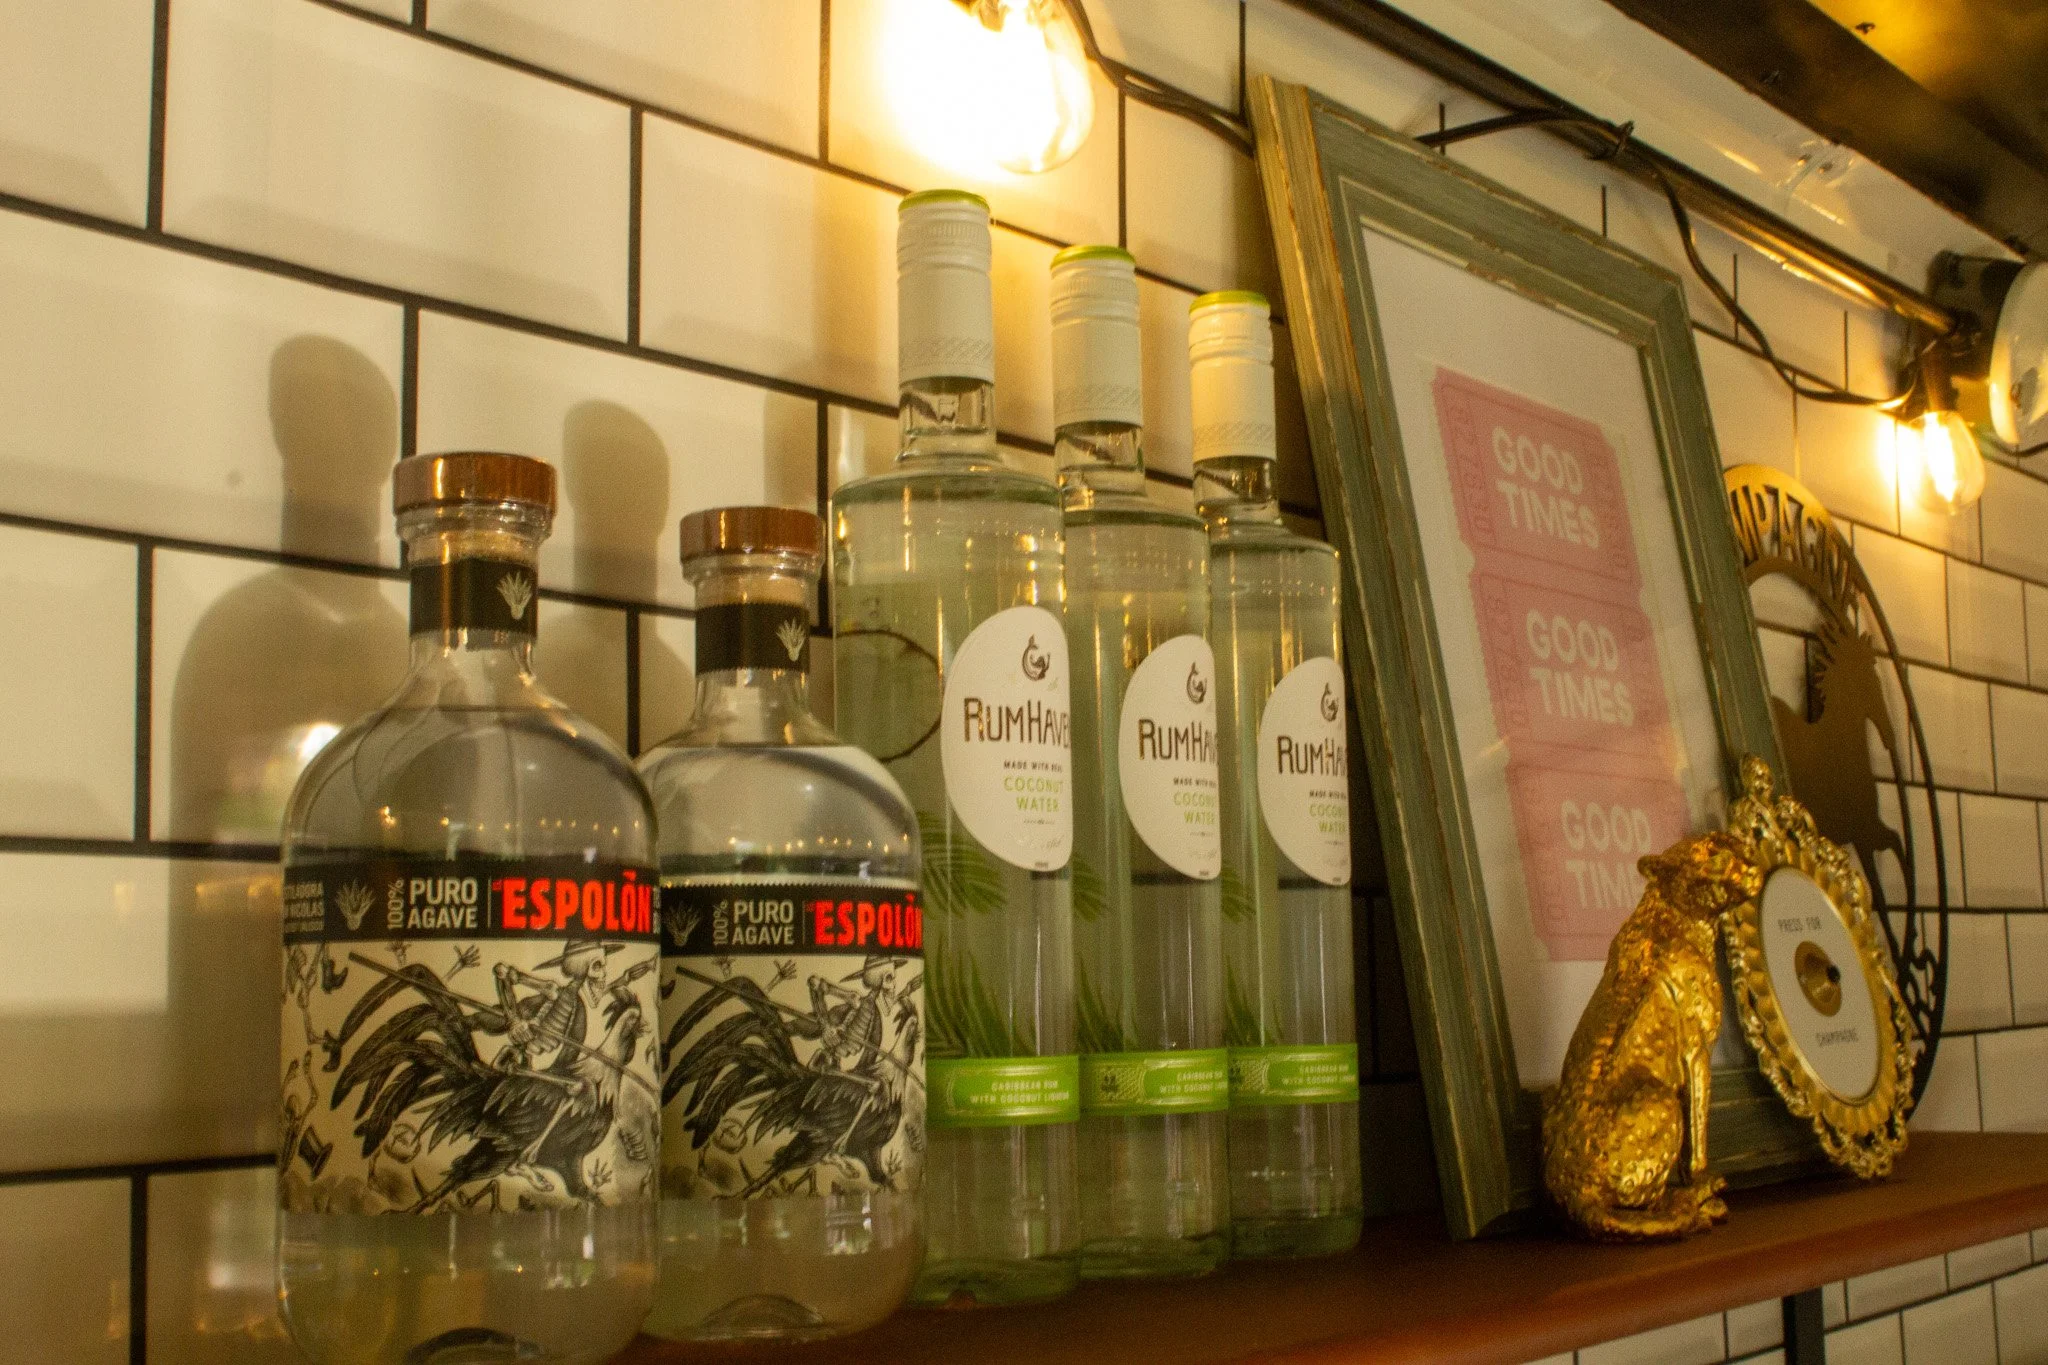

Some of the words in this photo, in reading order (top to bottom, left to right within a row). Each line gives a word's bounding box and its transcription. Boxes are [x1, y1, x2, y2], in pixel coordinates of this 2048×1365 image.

[1492, 426, 1583, 496] GOOD
[1497, 480, 1599, 549] TIMES
[1526, 608, 1619, 672] GOOD
[1528, 667, 1634, 728] TIMES
[1003, 760, 1028, 770] MADE
[1003, 776, 1064, 794] COCONUT
[1016, 796, 1060, 813] WATER
[1561, 800, 1650, 852] GOOD
[388, 878, 404, 929] 100%
[409, 877, 479, 905] PURO
[1565, 859, 1645, 909] TIME
[407, 905, 479, 929] AGAVE
[713, 900, 729, 946] 100%
[734, 900, 794, 924] PURO
[732, 925, 795, 946] AGAVE
